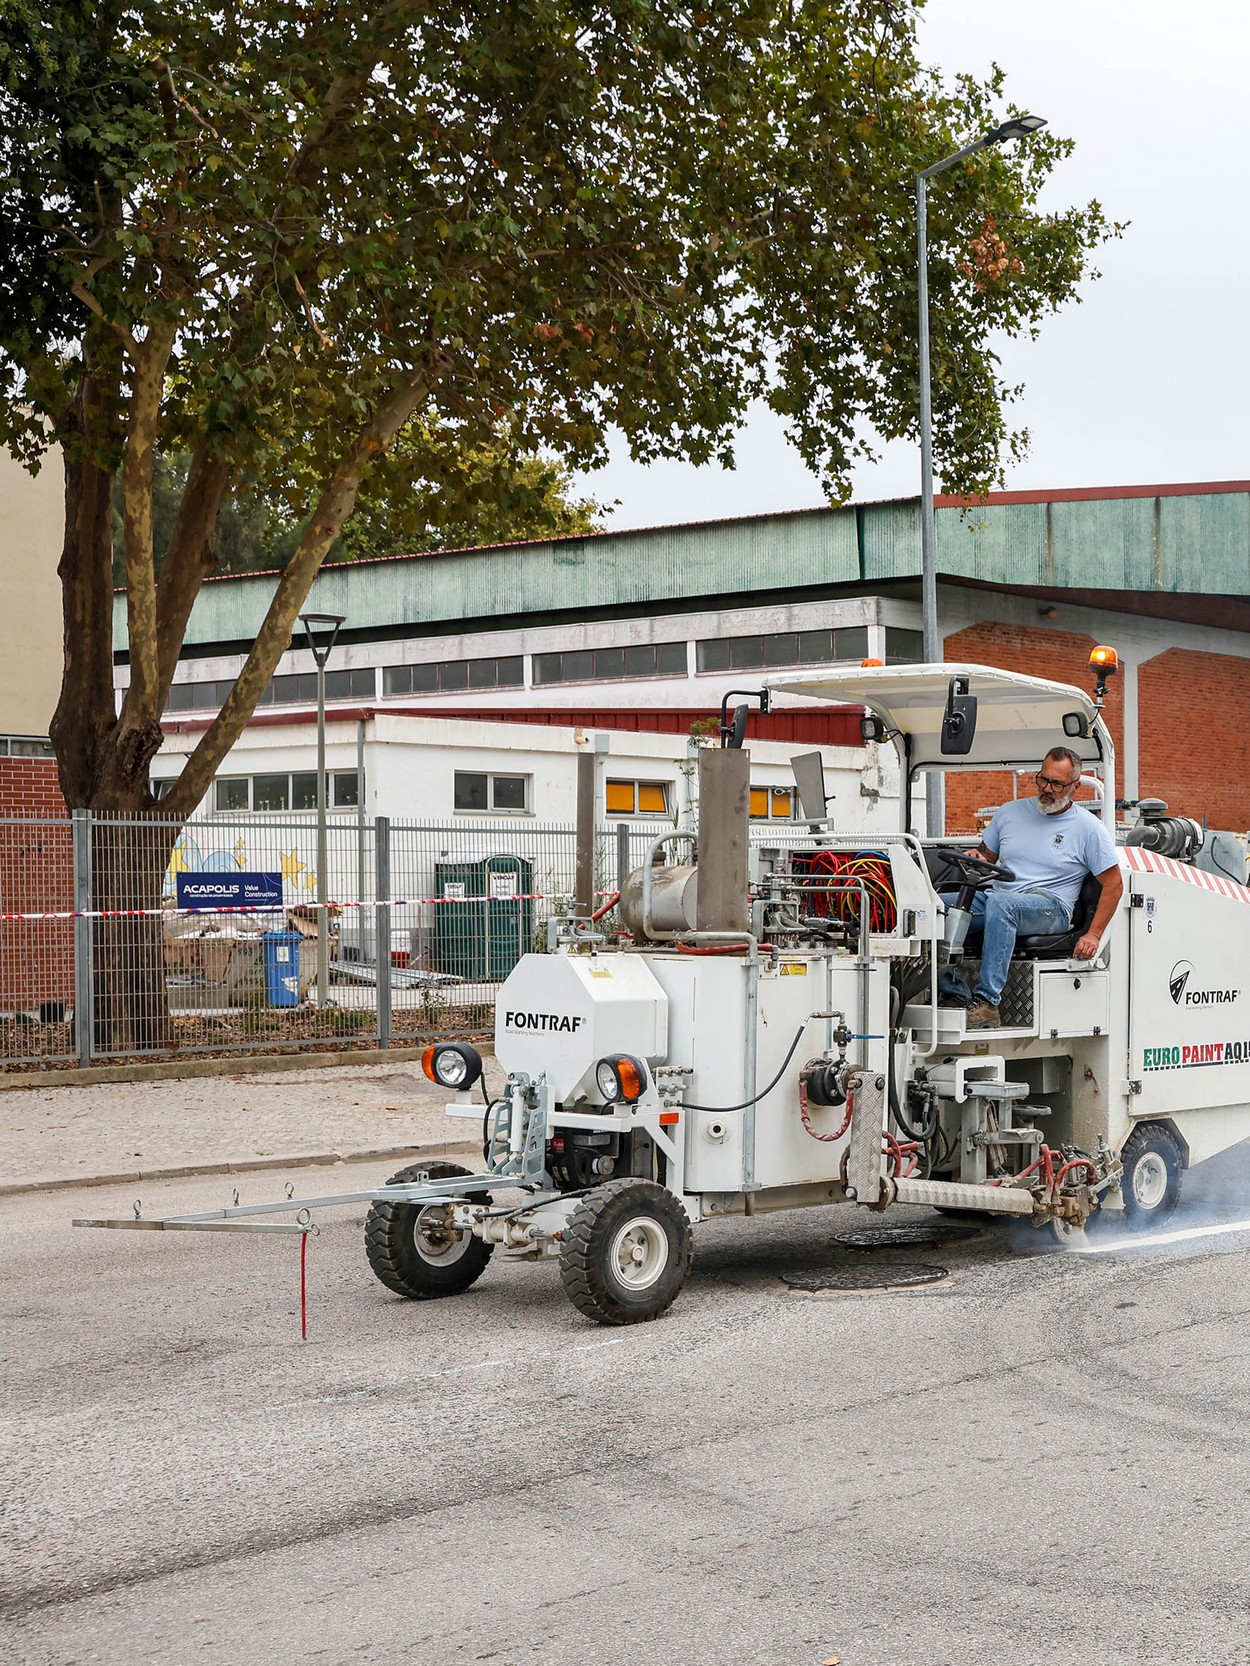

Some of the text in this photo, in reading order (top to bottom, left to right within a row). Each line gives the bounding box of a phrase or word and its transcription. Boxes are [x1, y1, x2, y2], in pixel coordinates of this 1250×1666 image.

[183, 885, 240, 894] ACAPOLIS
[1147, 920, 1153, 934] 6
[1185, 989, 1238, 1005] FONTRAF
[1143, 1047, 1180, 1067] EURO
[1182, 1043, 1224, 1063] PAINT
